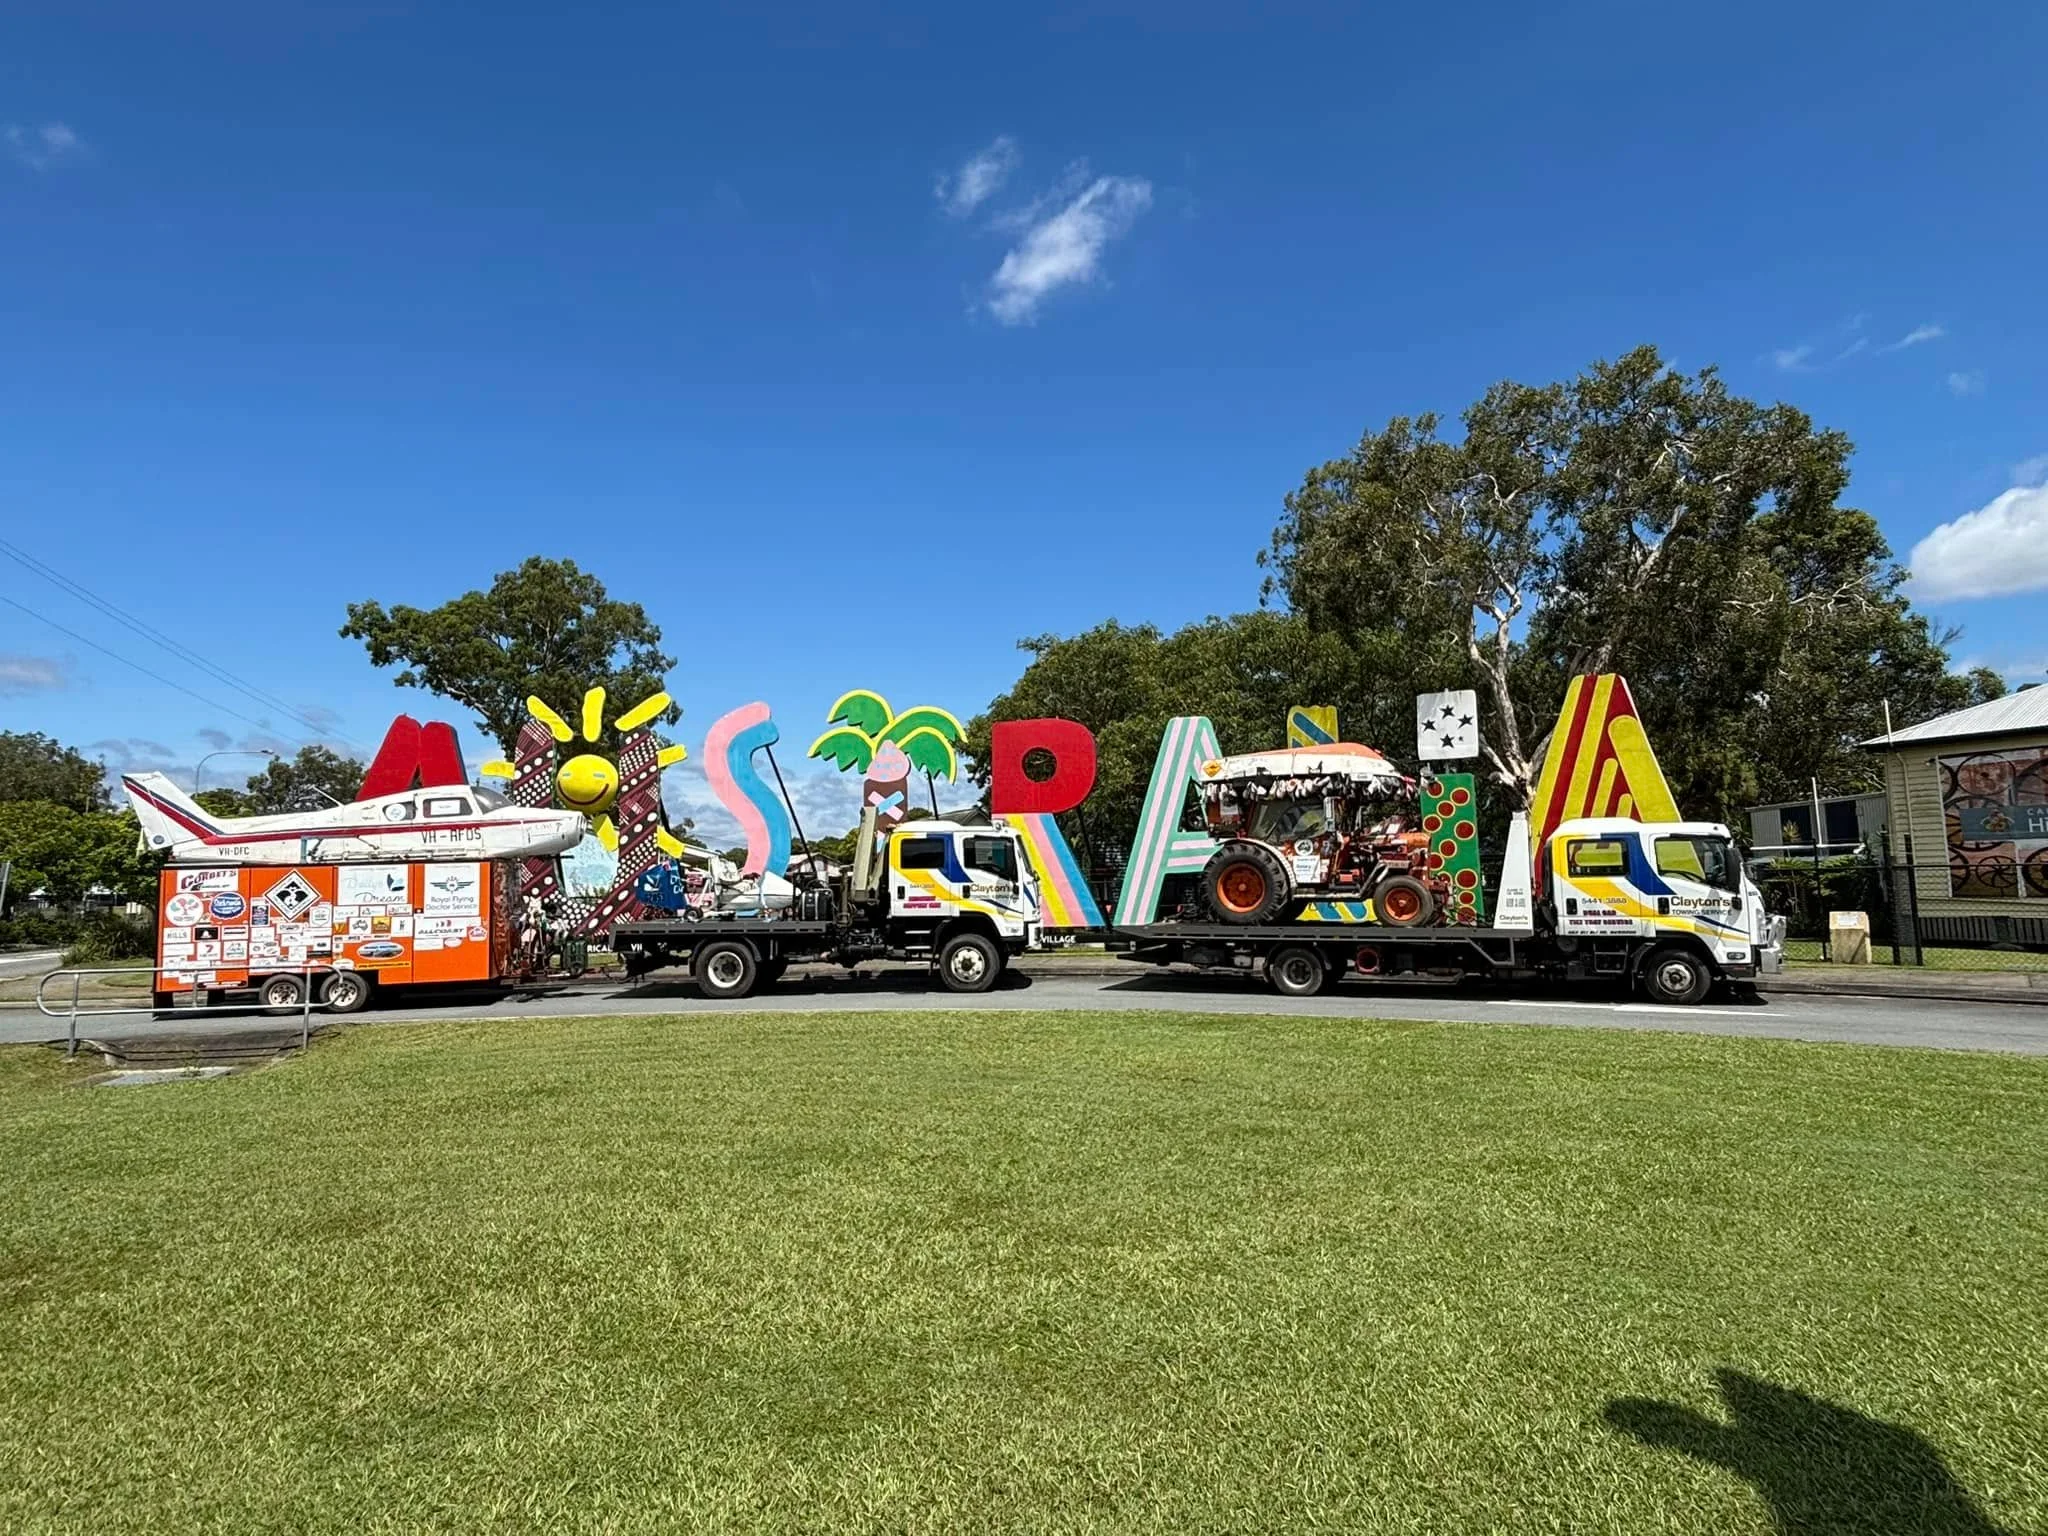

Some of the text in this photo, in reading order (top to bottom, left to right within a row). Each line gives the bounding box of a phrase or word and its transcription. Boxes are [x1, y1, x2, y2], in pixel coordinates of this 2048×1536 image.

[421, 830, 437, 844] VH
[355, 891, 405, 903] Dream
[430, 895, 474, 904] Royal Flying
[1670, 895, 1731, 909] Clayton's
[1702, 909, 1733, 917] SERVICE
[1041, 935, 1076, 944] VILLAGE
